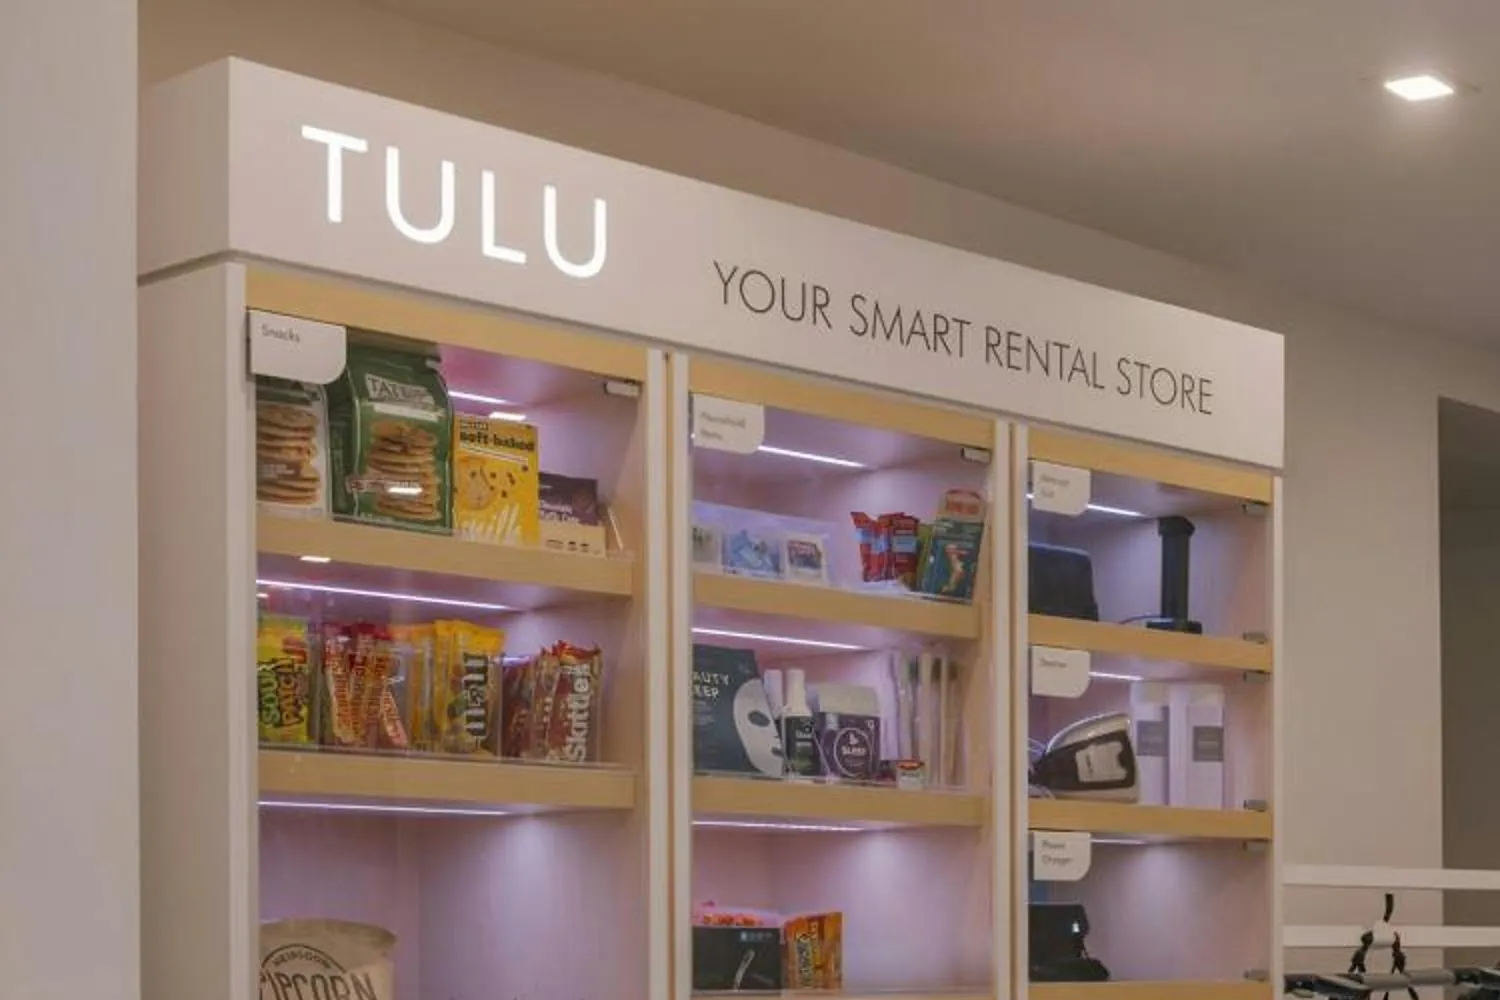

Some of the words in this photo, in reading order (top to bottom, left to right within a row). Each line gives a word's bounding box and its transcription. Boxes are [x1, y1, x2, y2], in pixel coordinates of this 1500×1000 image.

[301, 124, 607, 279] TULU
[260, 323, 300, 343] Snacks
[713, 260, 832, 329] YOUR
[849, 293, 972, 358] SMART
[984, 325, 1106, 391] RENTAL
[1116, 356, 1214, 416] STORE
[693, 671, 729, 686] AUTY
